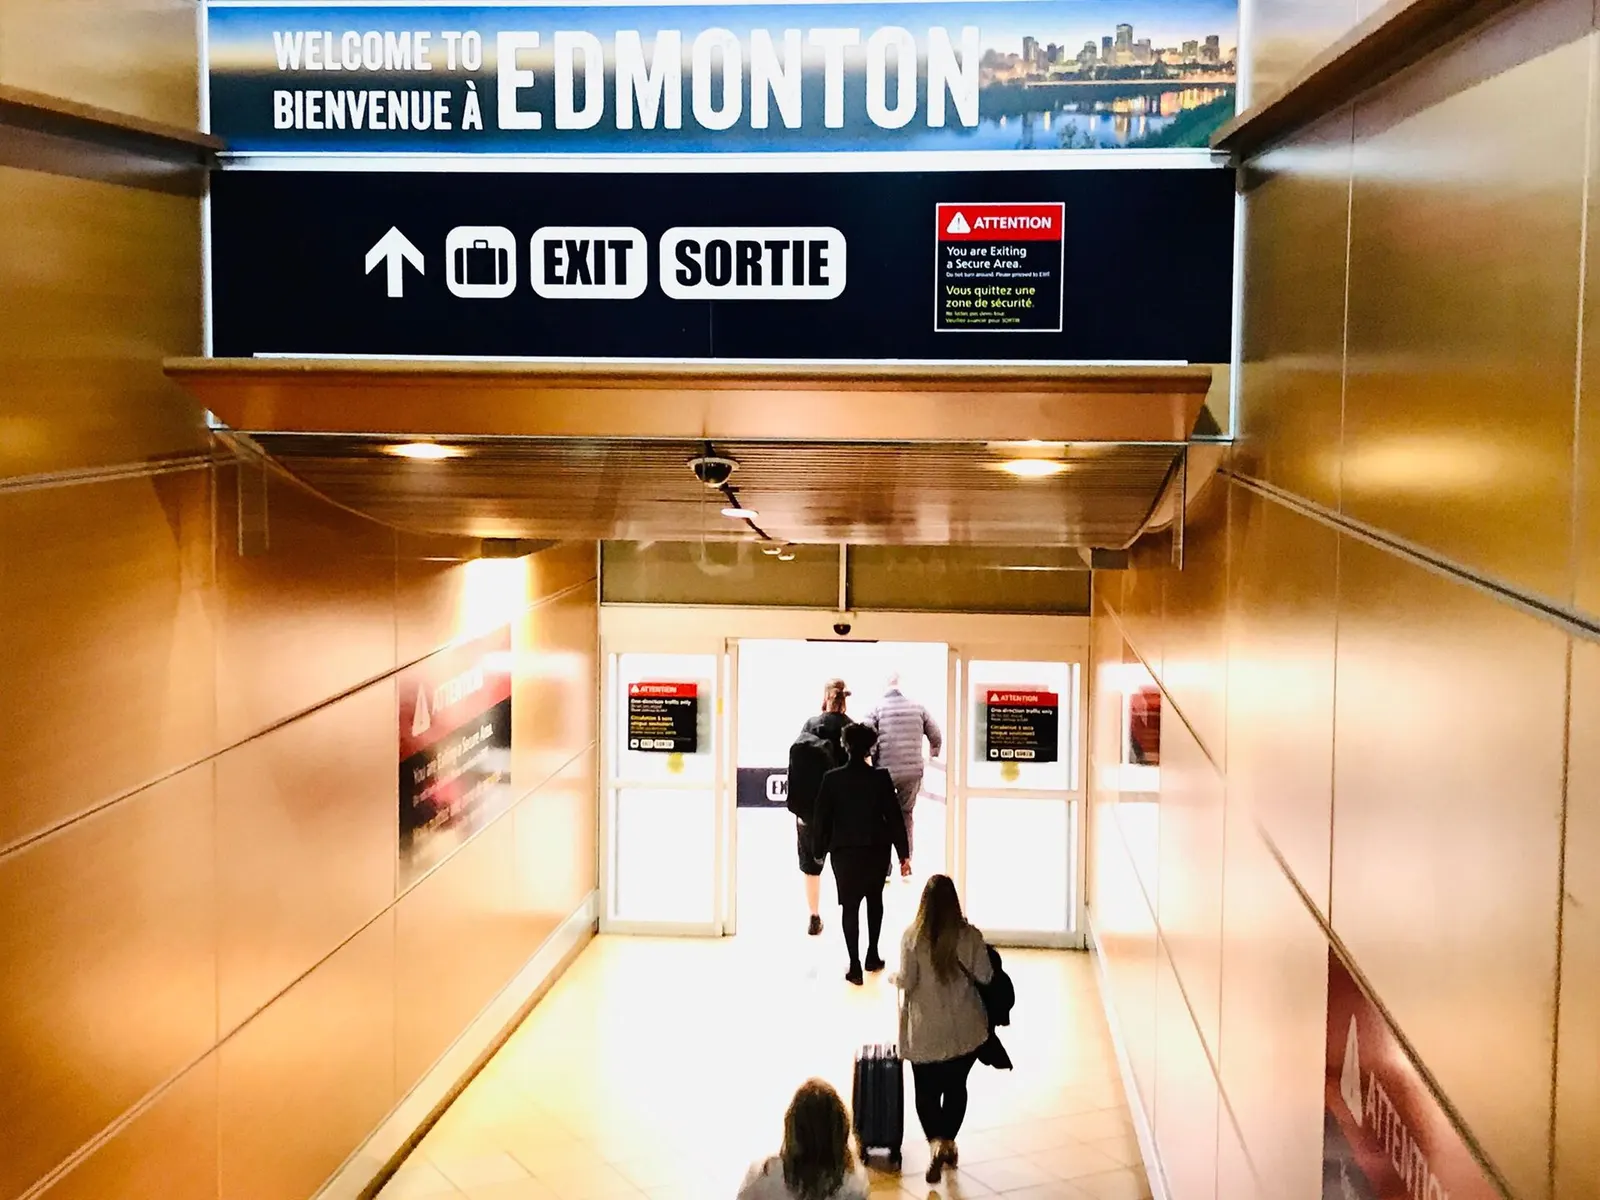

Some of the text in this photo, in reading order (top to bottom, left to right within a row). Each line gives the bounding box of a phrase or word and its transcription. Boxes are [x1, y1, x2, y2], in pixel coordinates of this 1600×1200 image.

[273, 30, 483, 71] WELCOME TO
[497, 26, 981, 131] EDMONTON
[273, 81, 484, 131] BIENVENUE À
[973, 216, 1052, 230] ATTENTION
[946, 246, 1027, 258] You are Exiting
[544, 240, 633, 287] EXIT
[675, 239, 829, 288] SORTIE
[946, 259, 1022, 269] a Secure Area.
[946, 285, 1036, 298] Vous quittez une
[945, 298, 1035, 308] zone de sécurité.
[1000, 694, 1038, 702] ATTENTION
[772, 780, 788, 795] EX
